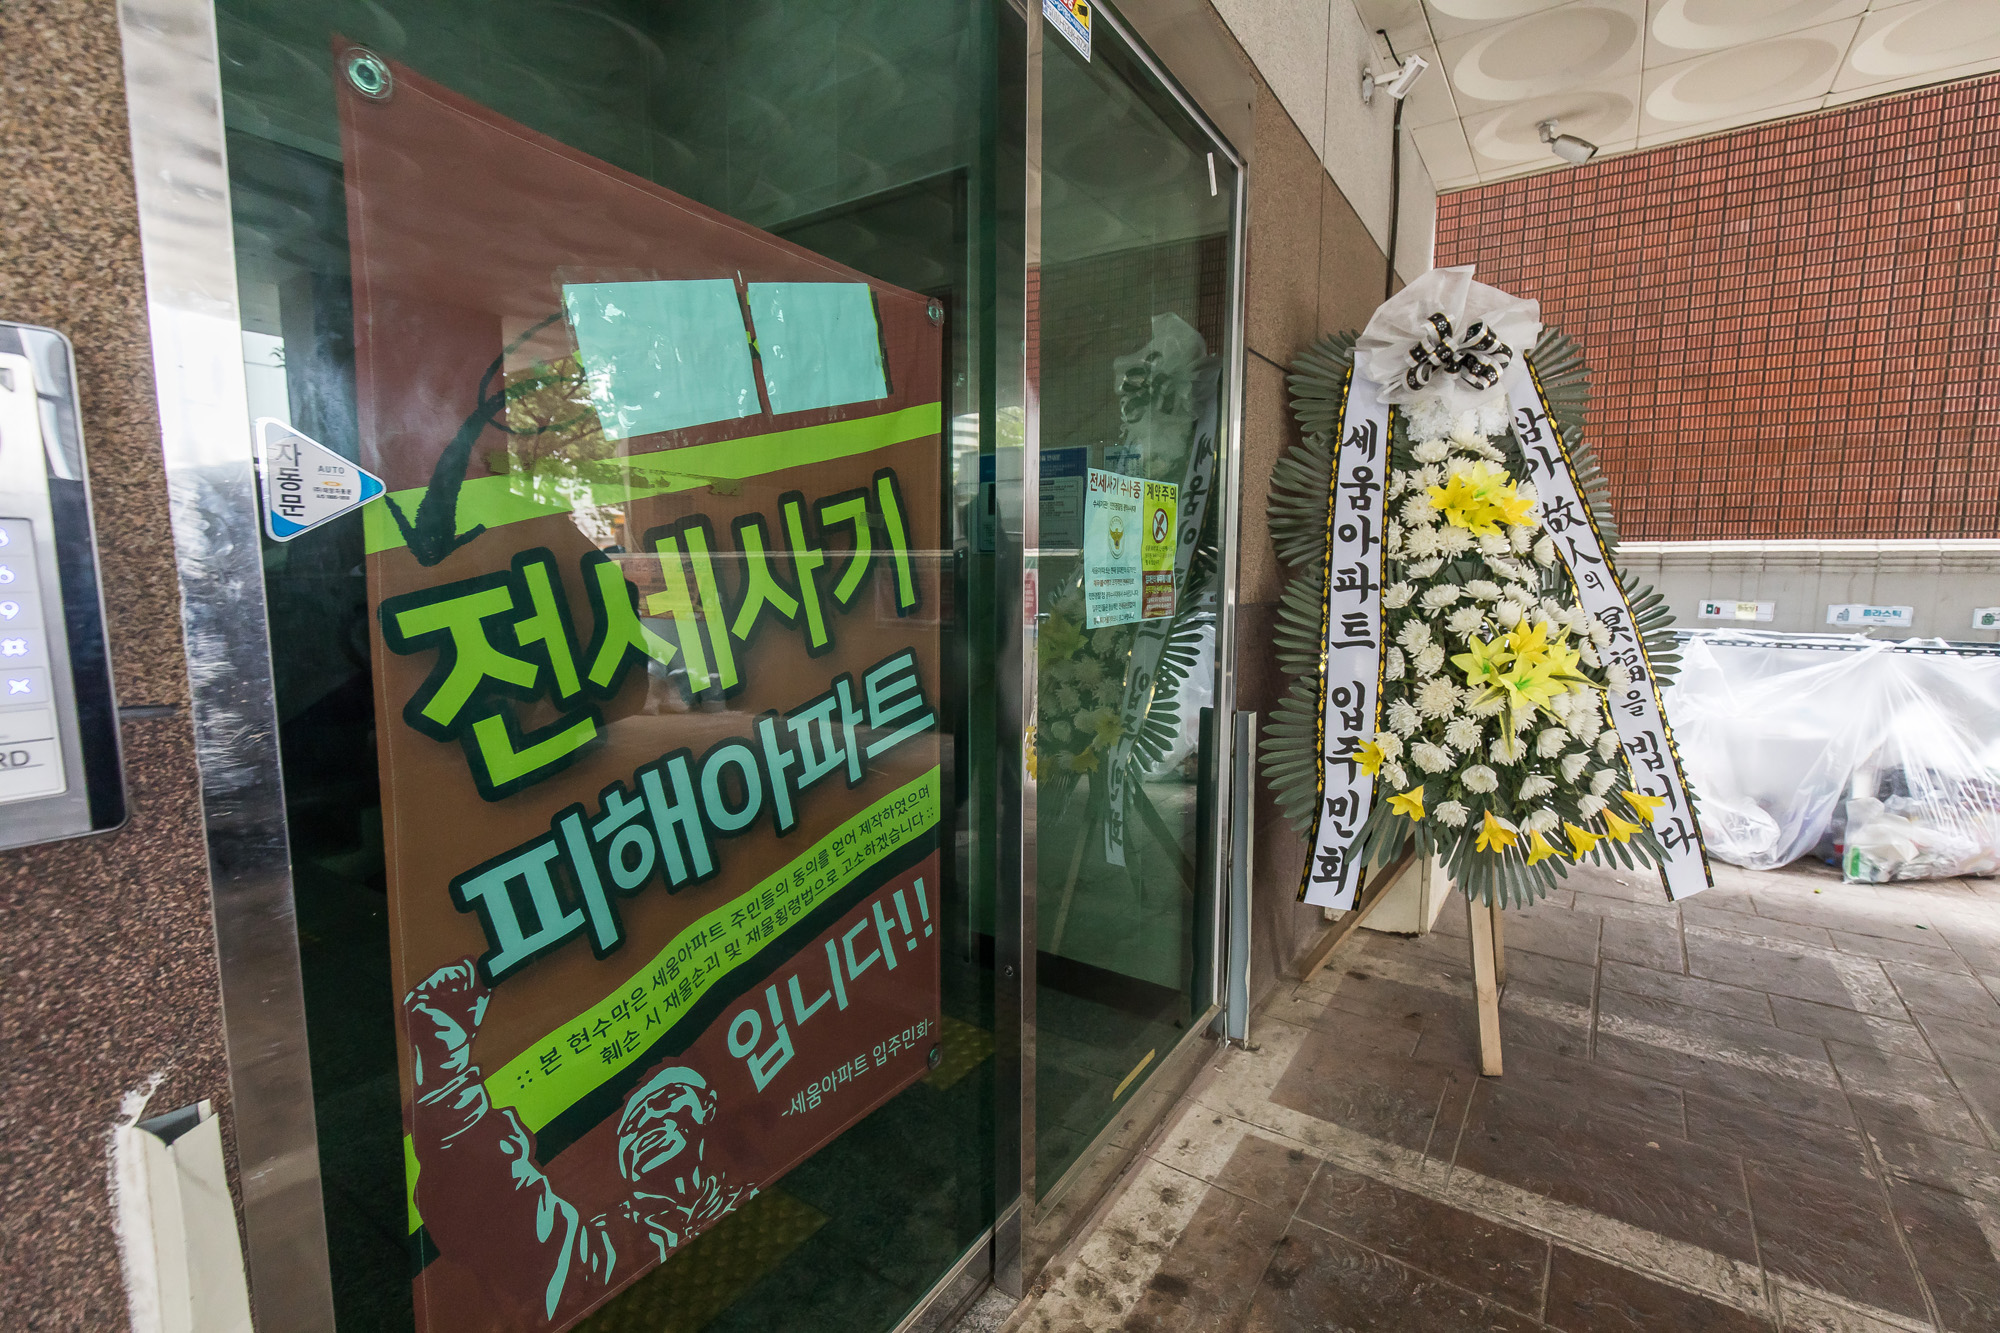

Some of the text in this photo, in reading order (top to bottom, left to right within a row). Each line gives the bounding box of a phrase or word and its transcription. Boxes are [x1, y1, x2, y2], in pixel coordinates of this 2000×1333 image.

[275, 443, 306, 517] 자동문
[318, 465, 345, 475] AUTO
[1090, 473, 1141, 499] 전세사기 수사중
[1146, 483, 1177, 503] 계약주의
[0, 601, 20, 620] 9
[396, 477, 916, 788] 전세사기
[1312, 419, 1380, 897] 세움아파트 입주민회
[461, 653, 936, 978] 피해아파트
[1624, 730, 1697, 856] 빕니다
[539, 1046, 562, 1076] 본
[566, 986, 648, 1055] 현수막은
[651, 921, 727, 991] 세움아파트
[730, 877, 790, 929] 주민들의
[792, 848, 830, 888] 동의를
[831, 829, 858, 858] 얻어
[859, 784, 930, 837] 제작하였으며
[599, 1028, 641, 1065] 훼손
[645, 1006, 662, 1031] 시
[662, 951, 721, 1013] 재물손괴
[724, 939, 743, 962] 및
[746, 868, 839, 946] 재물횡령법으로
[841, 811, 924, 876] 고소하겠습니다
[727, 877, 934, 1094] 입니다!!
[781, 1018, 934, 1117] -세움아파트 입주민회-
